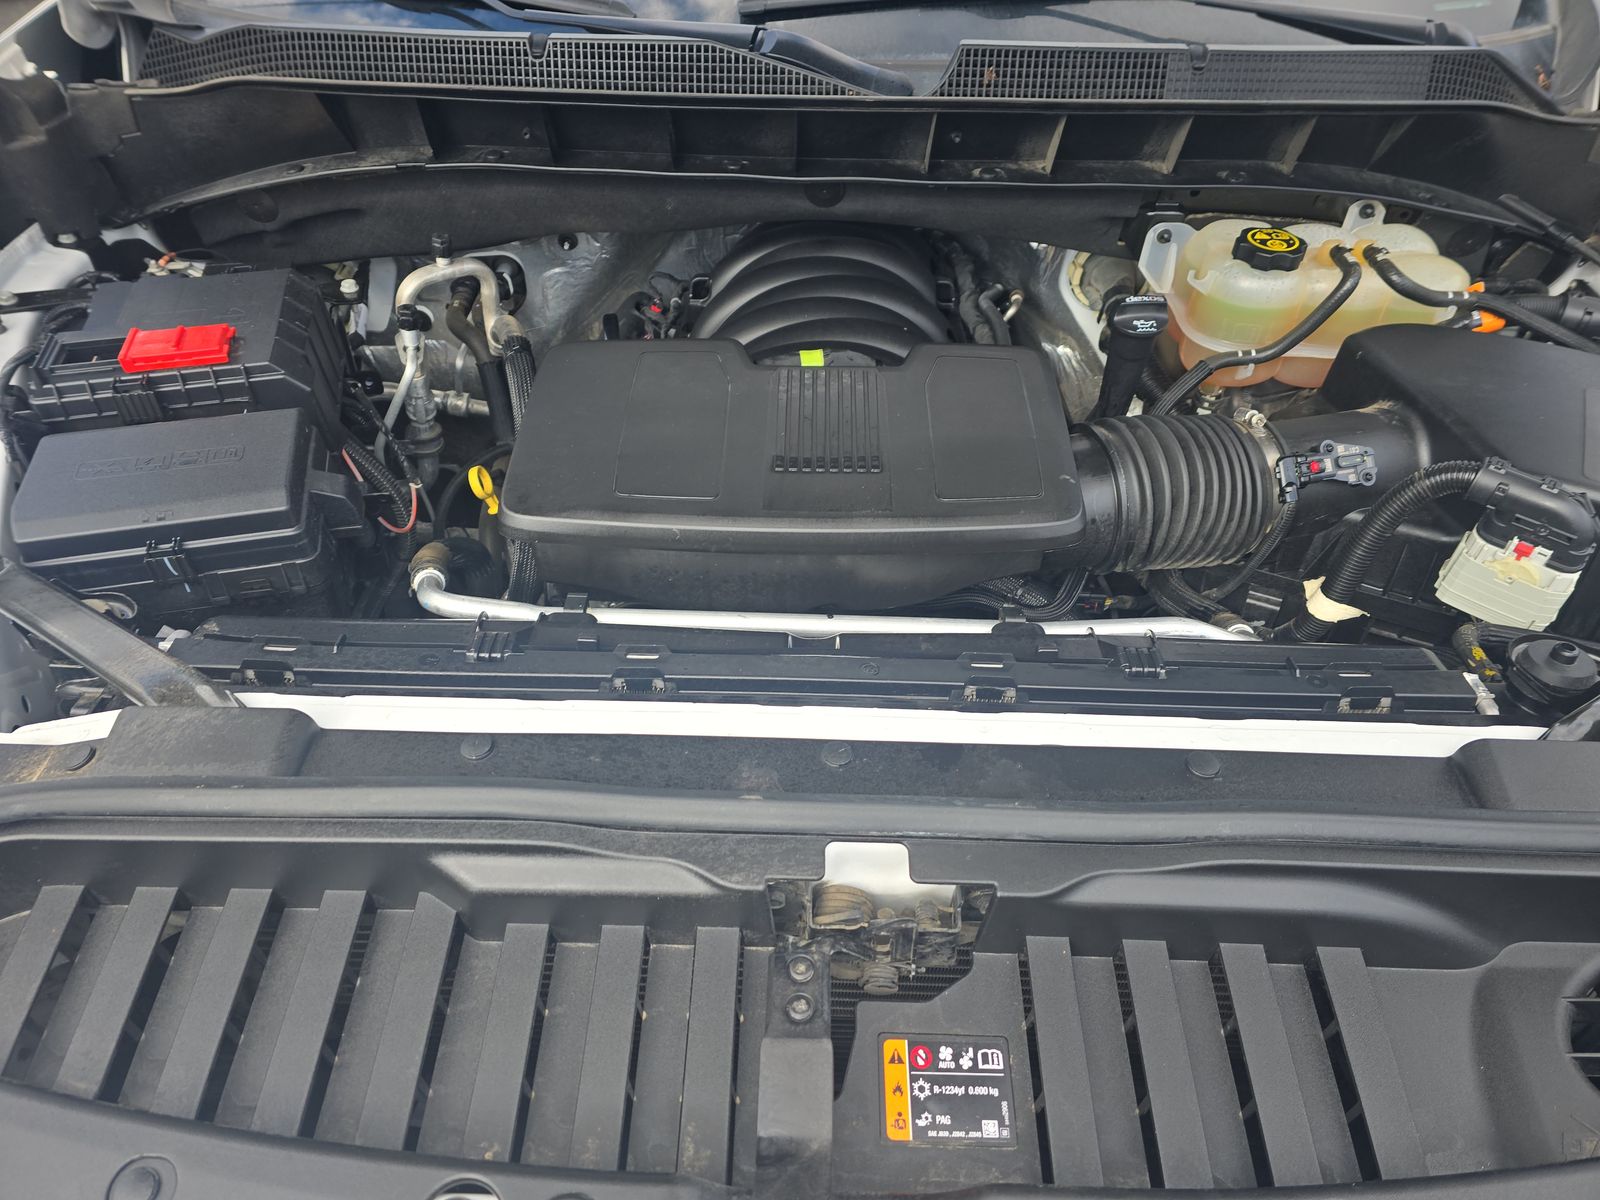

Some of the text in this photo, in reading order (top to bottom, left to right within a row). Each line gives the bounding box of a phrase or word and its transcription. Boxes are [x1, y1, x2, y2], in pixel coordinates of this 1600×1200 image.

[938, 1061, 955, 1069] AUTO
[933, 1085, 965, 1096] R-1234yf
[989, 1086, 999, 1097] kg
[935, 1115, 951, 1125] PAG
